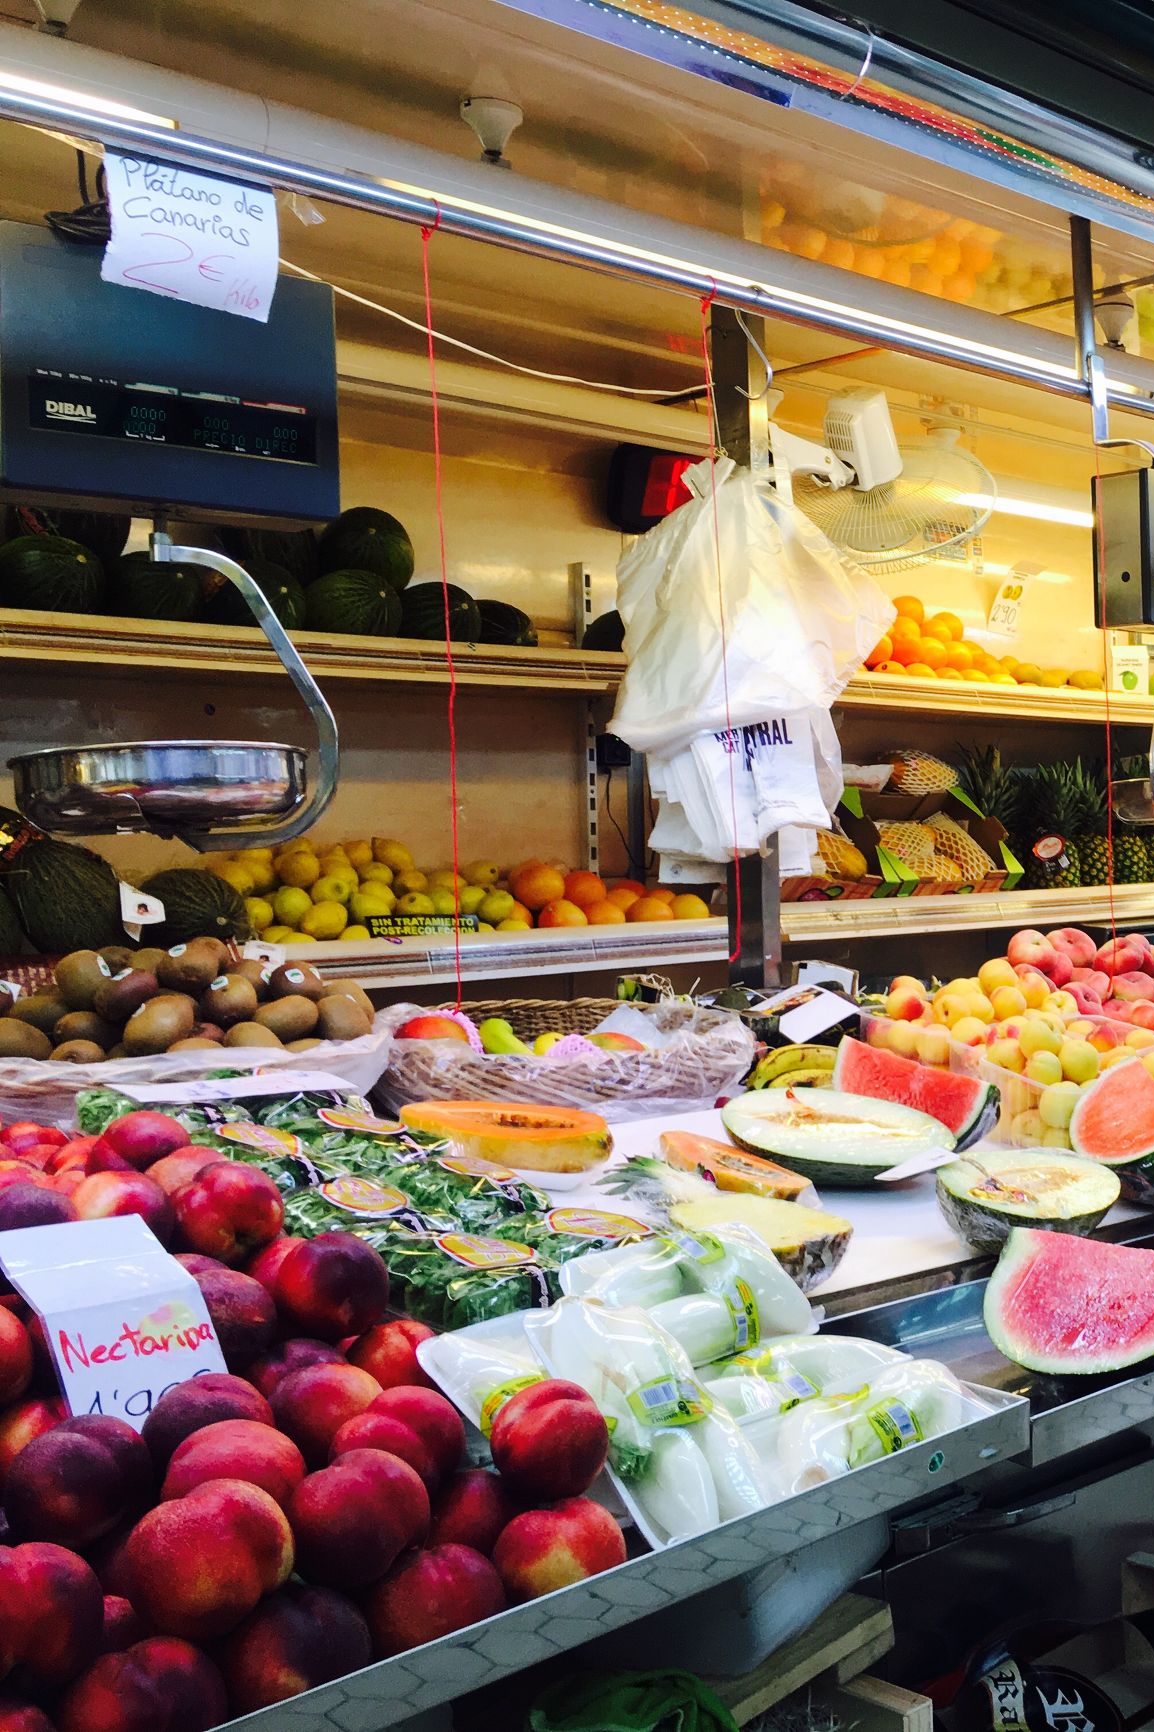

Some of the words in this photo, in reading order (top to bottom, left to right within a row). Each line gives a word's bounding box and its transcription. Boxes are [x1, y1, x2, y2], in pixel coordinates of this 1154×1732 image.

[119, 156, 222, 206] Plátano
[233, 191, 264, 222] de
[122, 196, 250, 247] Canarias
[45, 399, 97, 419] DIBAL
[370, 917, 392, 927] SIN
[396, 916, 475, 927] TRATAMIENTO
[58, 1321, 216, 1374] Nectarina
